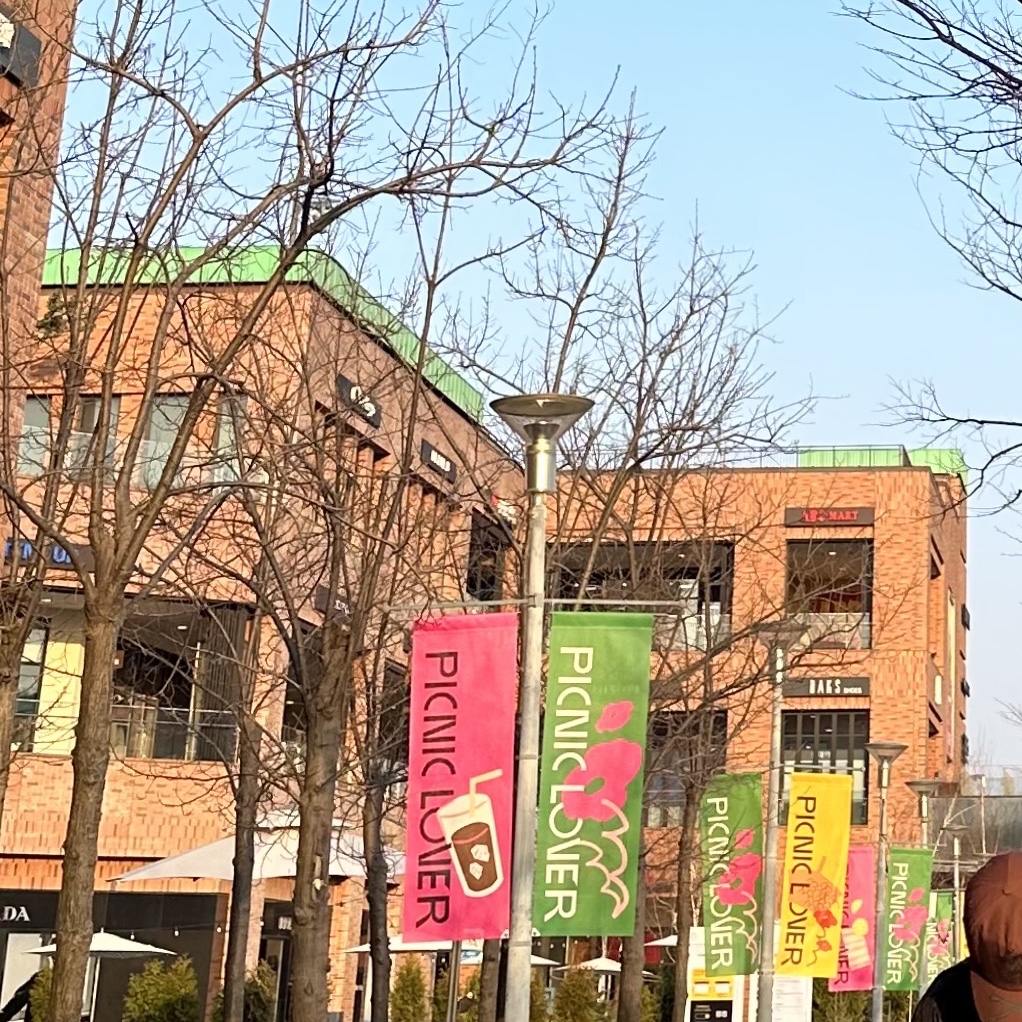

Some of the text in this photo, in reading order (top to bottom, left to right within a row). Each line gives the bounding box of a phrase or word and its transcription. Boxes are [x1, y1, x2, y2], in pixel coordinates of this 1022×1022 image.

[415, 651, 459, 928] PICNIC LOVER
[543, 646, 595, 922] PICNIC LOVER
[706, 796, 730, 876] PICNIC
[792, 796, 817, 874] PICNIC
[708, 883, 733, 970] LOVER
[886, 862, 909, 984] PICNIC LOVER
